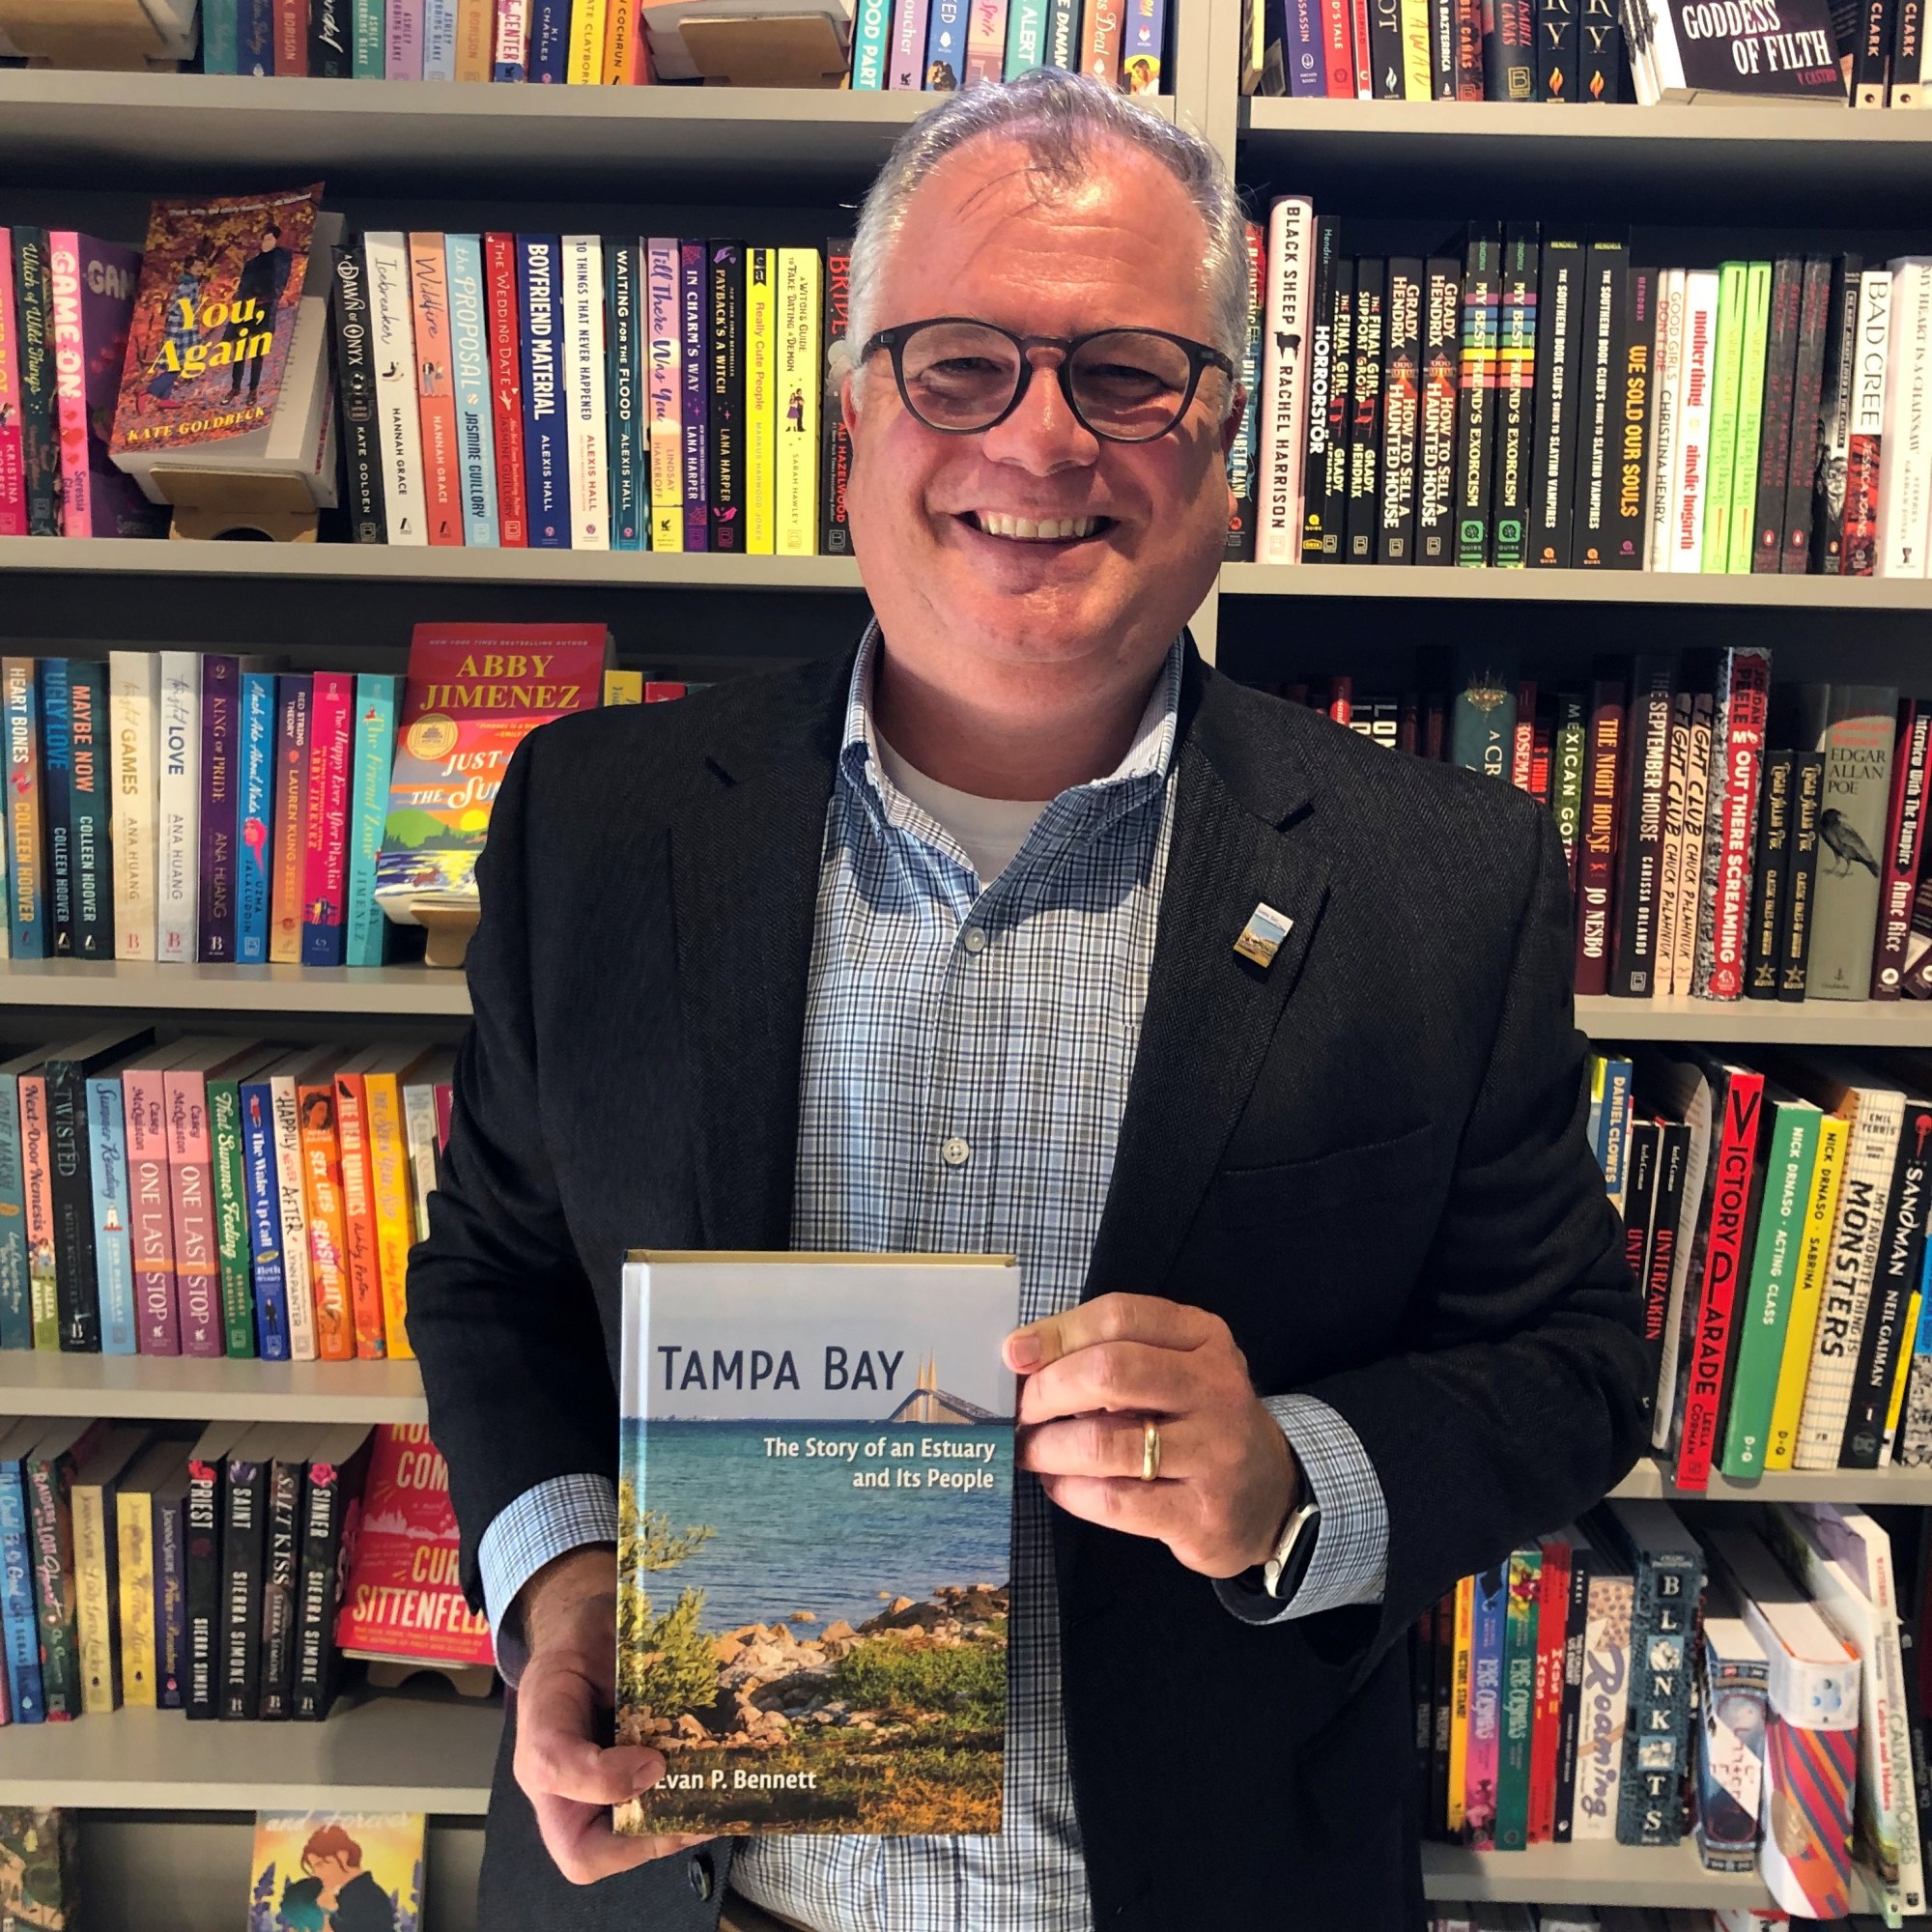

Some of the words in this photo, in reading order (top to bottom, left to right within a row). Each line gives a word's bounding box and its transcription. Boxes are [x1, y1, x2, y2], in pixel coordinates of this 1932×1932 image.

[503, 13, 522, 61] CENTER
[541, 6, 552, 62] CHARLES
[613, 8, 626, 67] COCHRUN
[1021, 8, 1038, 69] ALERT
[1052, 14, 1068, 69] DANAN
[1092, 16, 1109, 55] Deal
[1333, 27, 1343, 49] TALE
[1438, 6, 1451, 72] BAZTERRICA
[1682, 0, 1780, 40] GODDESS
[1867, 4, 1883, 56] CLARK
[1903, 4, 1918, 57] CLARK
[582, 23, 592, 85] CLAYBORN
[1732, 38, 1760, 75] OF
[1766, 30, 1833, 73] FILTH
[1285, 207, 1299, 265] BLACK
[51, 251, 80, 345] GAME
[375, 257, 401, 346] Icebreaker
[414, 256, 442, 340] Wildfire
[527, 243, 552, 336] BOYFRIEND
[686, 270, 698, 288] IN
[1283, 269, 1297, 326] SHEEP
[176, 297, 266, 332] You,
[686, 291, 700, 357] CHARM'S
[1391, 276, 1407, 348] HENDRIX
[1405, 284, 1420, 342] GRADY
[1430, 274, 1445, 347] HENDRIX
[1443, 282, 1458, 340] GRADY
[1866, 281, 1889, 344] BAD
[57, 350, 83, 398] ON
[148, 327, 273, 380] Again
[687, 359, 700, 393] WAY
[1629, 346, 1647, 374] WE
[1688, 310, 1708, 407] motherthing
[531, 339, 555, 421] MATERIAL
[1275, 366, 1293, 434] RACHEL
[1309, 326, 1330, 455] HORRORSTÖR
[1627, 376, 1645, 421] SOLD
[1861, 354, 1884, 427] CREE
[128, 425, 173, 443] KATE
[178, 407, 265, 437] GOLDBECK
[356, 427, 366, 456] KATE
[392, 408, 405, 456] HANNAH
[464, 412, 480, 461] JASMINE
[687, 426, 697, 453] LANA
[1386, 384, 1405, 469] HAUNTED
[1424, 383, 1442, 468] HAUNTED
[1623, 424, 1642, 461] OUR
[1657, 390, 1672, 468] CHRISTINA
[397, 459, 408, 496] GRACE
[541, 435, 552, 476] ALEXIS
[620, 434, 631, 475] ALEXIS
[688, 456, 698, 500] HARPER
[1350, 442, 1364, 498] HENDRIX
[1685, 444, 1699, 493] ainslie
[359, 463, 371, 514] GOLDEN
[469, 465, 486, 518] GUILLORY
[542, 480, 554, 512] HALL
[622, 479, 632, 511] HALL
[1272, 439, 1289, 528] HARRISON
[1384, 471, 1400, 528] HOUSE
[1421, 469, 1437, 527] HOUSE
[1620, 464, 1640, 518] SOULS
[1654, 473, 1666, 524] HENRY
[1681, 495, 1697, 551] hogarth
[10, 668, 27, 713] HEART
[456, 655, 554, 678] ABBY
[45, 672, 68, 722] UGLY
[72, 685, 92, 745] MAYBE
[420, 684, 580, 711] JIMENEZ
[12, 716, 28, 763] BONES
[46, 724, 69, 771] LOVE
[1599, 718, 1619, 748] THE
[1669, 699, 1690, 780] FIGHT
[1689, 698, 1711, 779] FIGHT
[1830, 748, 1887, 764] EDGAR
[74, 751, 94, 793] NOW
[441, 750, 502, 777] JUST
[1594, 753, 1615, 801] NIGHT
[1733, 750, 1751, 788] OUT
[1828, 780, 1860, 795] POE
[1830, 764, 1885, 781] ALLAN
[411, 787, 443, 806] THE
[1663, 781, 1683, 838] CLUB
[1684, 781, 1704, 838] CLUB
[1727, 790, 1748, 852] THERE
[14, 803, 33, 864] COLLEEN
[54, 827, 68, 874] COLLEEN
[80, 815, 94, 869] COLLEEN
[1586, 804, 1613, 854] HOUSE
[1662, 841, 1678, 887] CHUCK
[1682, 841, 1699, 886] CHUCK
[18, 867, 34, 923] HOOVER
[57, 877, 70, 923] HOOVER
[83, 872, 97, 923] HOOVER
[355, 869, 367, 944] JIMENEZ
[1719, 854, 1743, 965] SCREAMING
[1890, 880, 1912, 917] Anne
[1659, 889, 1676, 959] PALAHNIUK
[1678, 889, 1696, 960] PALAHNIUK
[1886, 919, 1907, 952] Rice
[23, 1085, 42, 1164] Next-Door
[131, 1087, 144, 1151] McQuiston
[215, 1091, 233, 1133] That
[1609, 1076, 1626, 1126] DANIEL
[54, 1090, 76, 1178] TWISTED
[1605, 1127, 1621, 1183] CLOWES
[1788, 1126, 1804, 1159] NICK
[1826, 1132, 1837, 1163] NICK
[139, 1162, 160, 1206] ONE
[181, 1165, 201, 1208] ONE
[218, 1133, 237, 1201] Summer
[1715, 1089, 1760, 1247] VICTORY
[1780, 1163, 1799, 1217] DRNASO
[27, 1167, 43, 1238] Nemesis
[1813, 1167, 1832, 1220] DRNASO
[142, 1212, 164, 1266] LAST
[184, 1216, 207, 1268] LAST
[218, 1201, 240, 1260] Feeling
[1770, 1229, 1788, 1280] ACTING
[1645, 1229, 1674, 1341] UNTERZAKHN
[1802, 1237, 1821, 1292] SABRINA
[1820, 1179, 1874, 1358] MONSTERS
[145, 1271, 167, 1321] STOP
[187, 1275, 210, 1325] STOP
[1762, 1284, 1779, 1326] CLASS
[1695, 1251, 1733, 1396] PARADE
[657, 1346, 801, 1390] TAMPA
[824, 1346, 905, 1390] BAY
[763, 1436, 800, 1458] The
[805, 1436, 859, 1463] Story
[864, 1435, 889, 1458] of
[890, 1442, 916, 1458] an
[921, 1437, 996, 1463] Estuary
[189, 1478, 213, 1530] PRIEST
[274, 1473, 295, 1530] SALT
[853, 1466, 891, 1488] and
[896, 1467, 922, 1488] Its
[926, 1467, 994, 1492] People
[232, 1488, 252, 1529] SAINT
[309, 1488, 331, 1539] SINNER
[271, 1532, 292, 1587] KISS
[231, 1571, 248, 1625] SIERRA
[307, 1571, 324, 1624] SIERRA
[229, 1630, 245, 1685] SIMONE
[301, 1630, 320, 1684] SIMONE
[1536, 1654, 1548, 1700] MAUS
[1550, 1648, 1562, 1694] MAUS
[1580, 1642, 1625, 1819] Roaming
[711, 1769, 727, 1789] P.
[733, 1769, 817, 1789] Bennett
